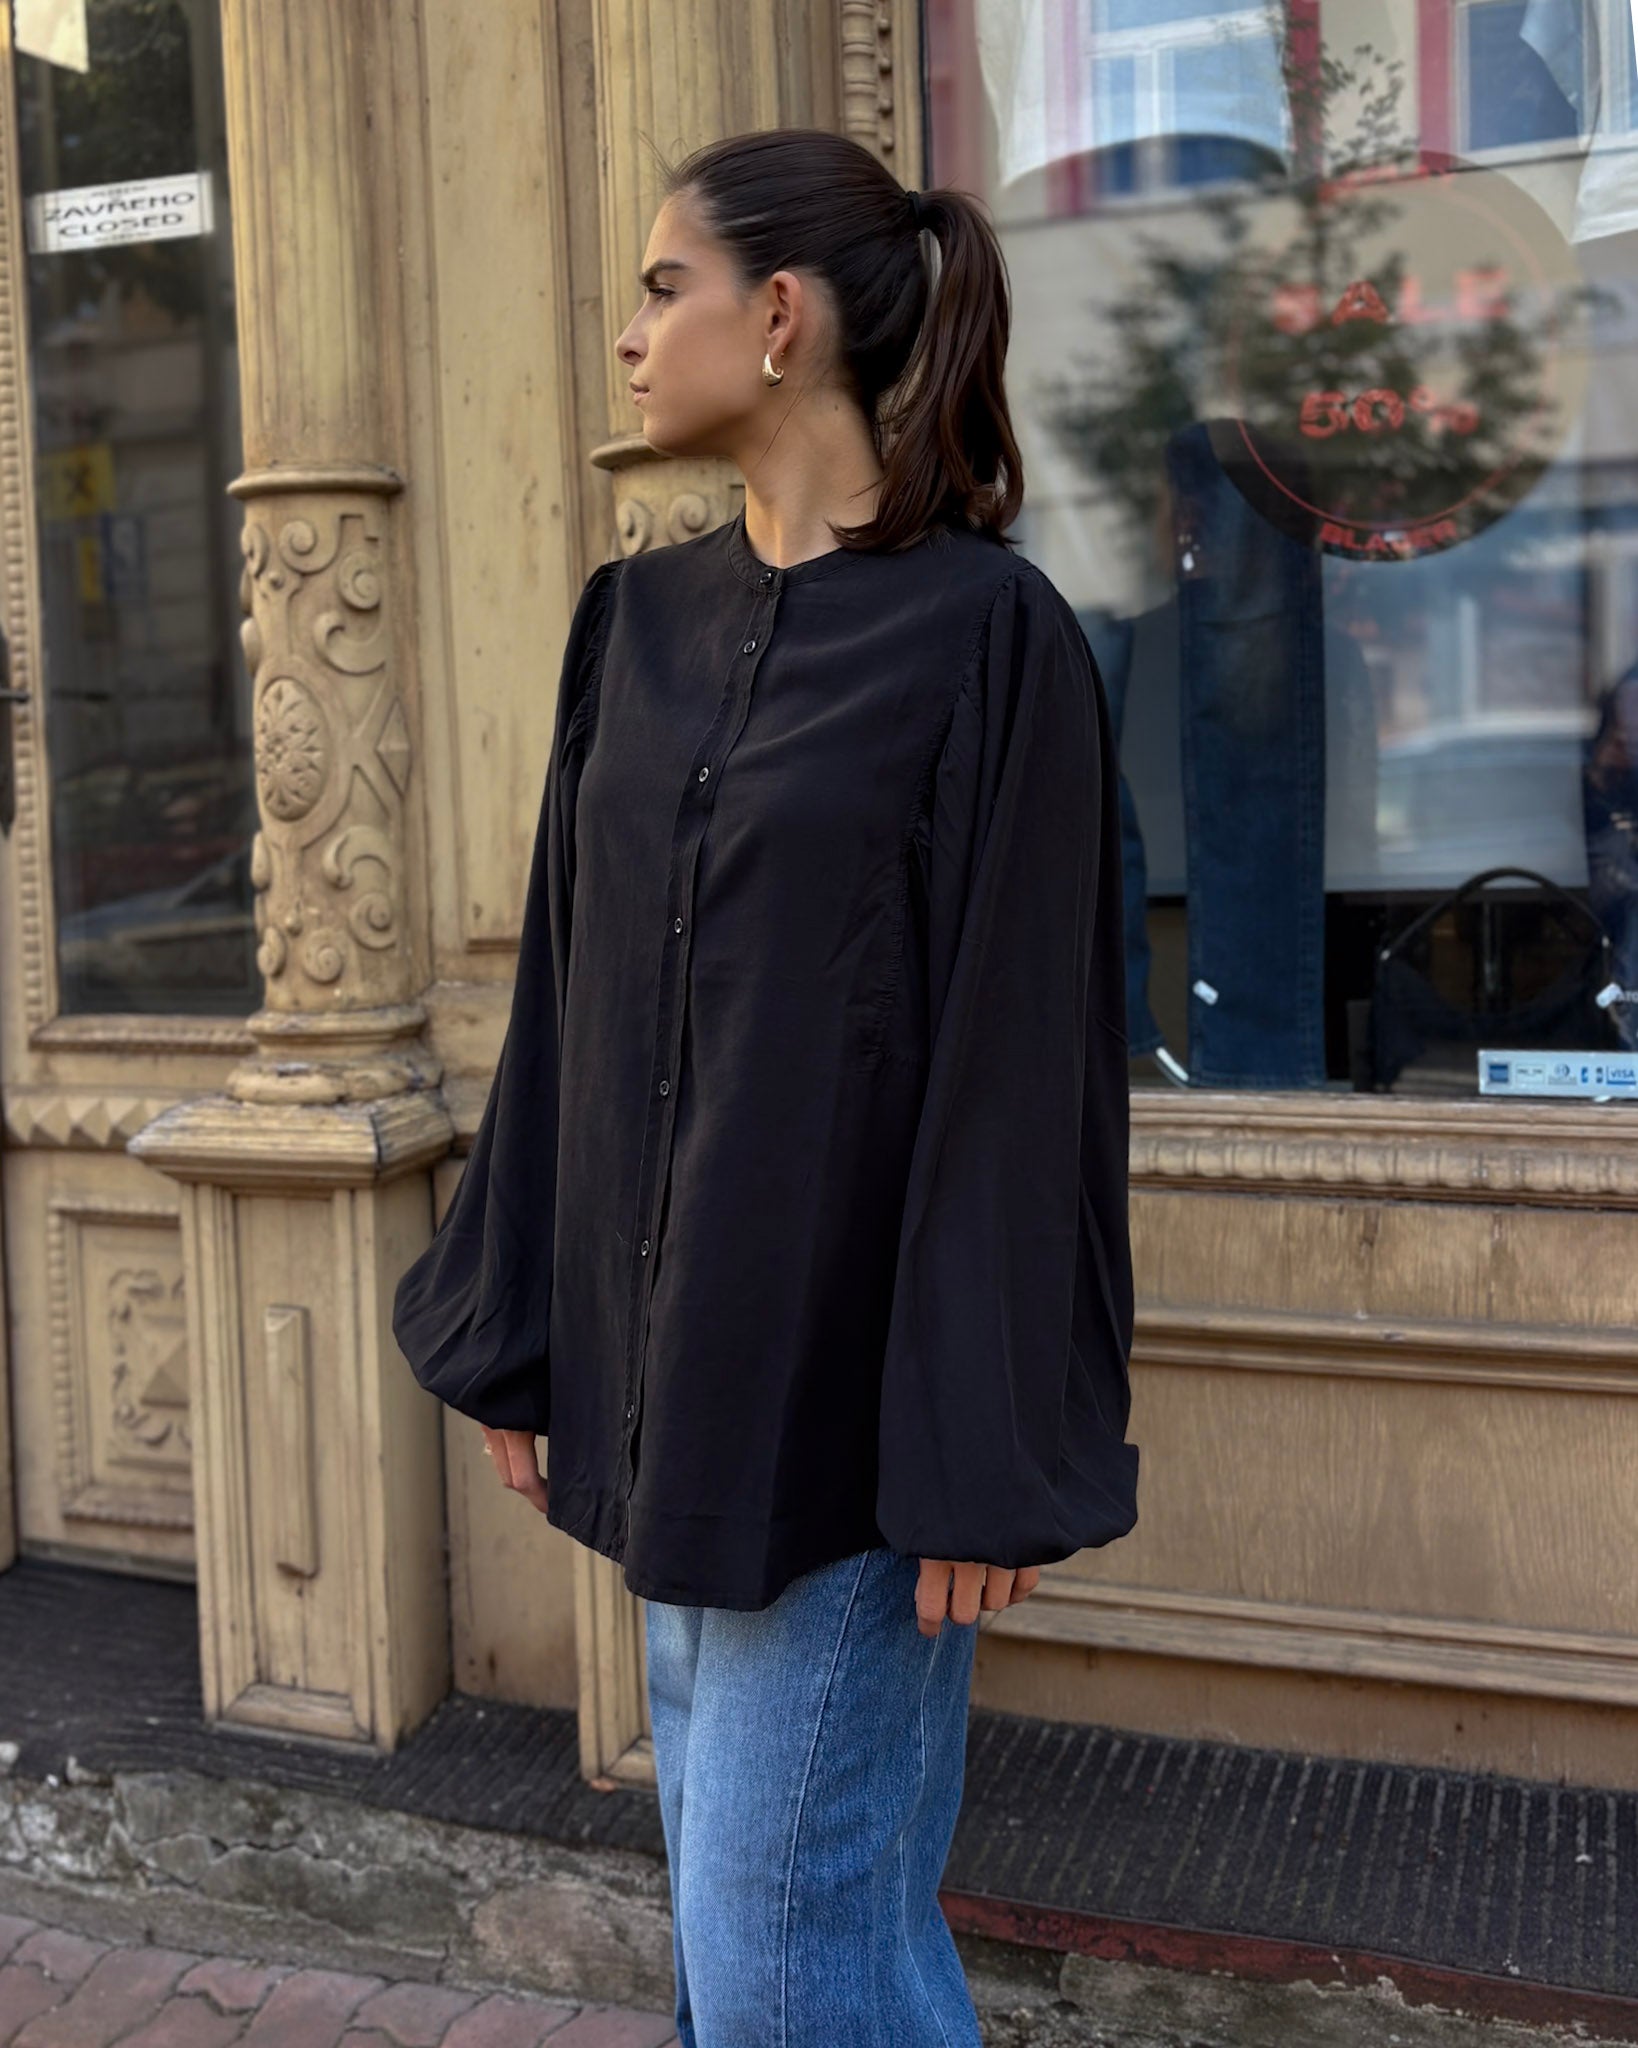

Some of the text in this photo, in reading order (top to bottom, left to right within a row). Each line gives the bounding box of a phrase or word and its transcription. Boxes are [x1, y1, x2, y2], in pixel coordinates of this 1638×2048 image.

[59, 212, 183, 237] CLOSED
[1272, 268, 1510, 335] SALE
[1299, 384, 1479, 439] 50%
[1611, 1069, 1635, 1078] VISA
